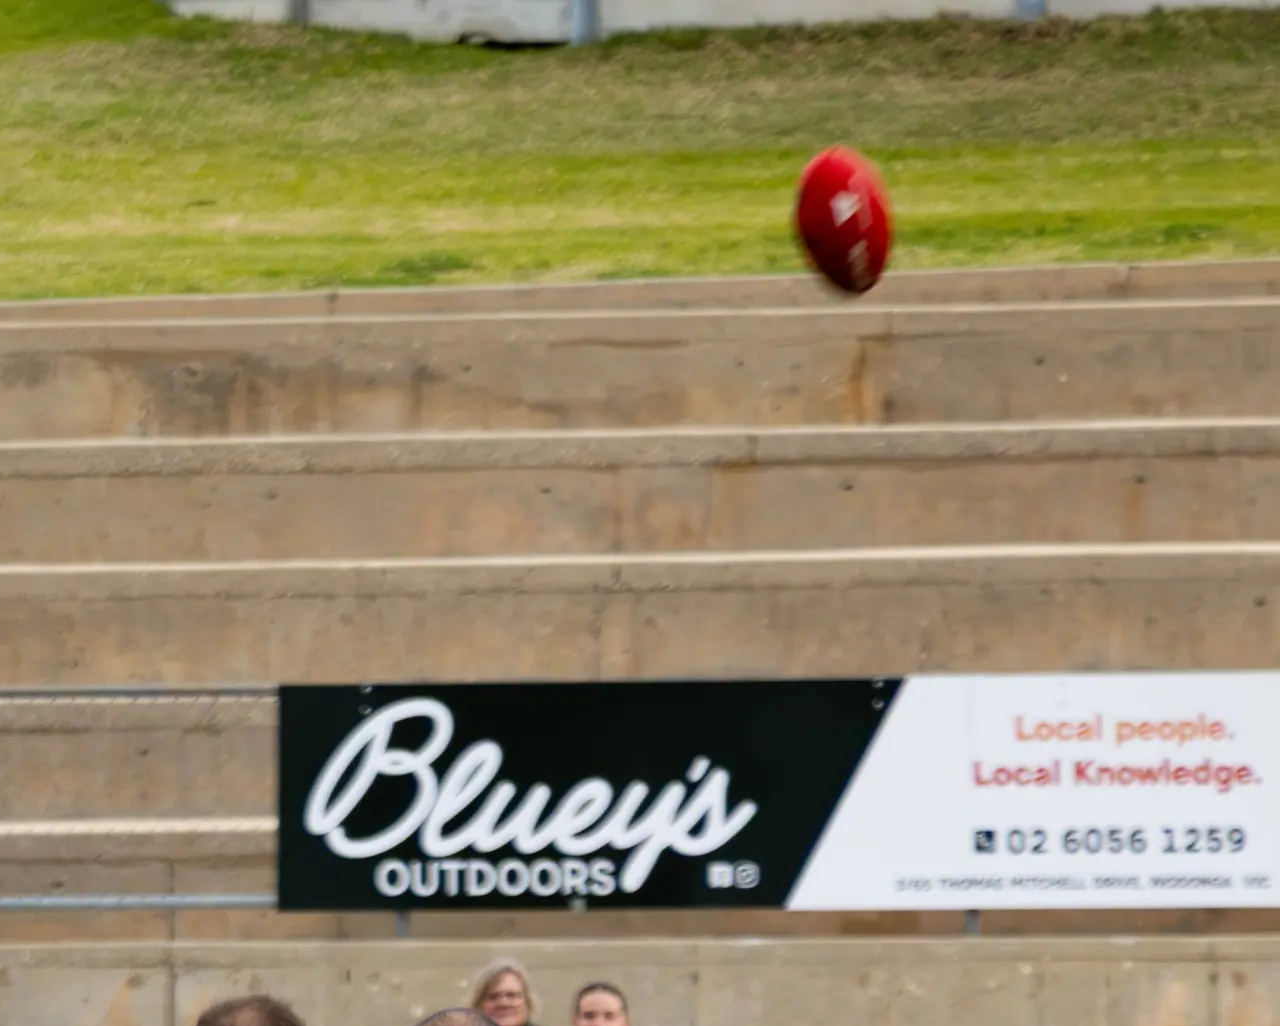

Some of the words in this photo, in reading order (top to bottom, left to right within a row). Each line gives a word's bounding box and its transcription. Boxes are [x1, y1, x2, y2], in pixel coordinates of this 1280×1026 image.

[1015, 715, 1103, 742] Local
[1116, 714, 1236, 746] people.
[973, 760, 1061, 786] Local
[1074, 759, 1263, 793] Knowledge.
[304, 697, 758, 893] Bluey's
[1007, 829, 1048, 855] 02
[1062, 829, 1147, 855] 6056
[1161, 827, 1247, 853] 1259
[375, 858, 616, 897] OUTDOORS
